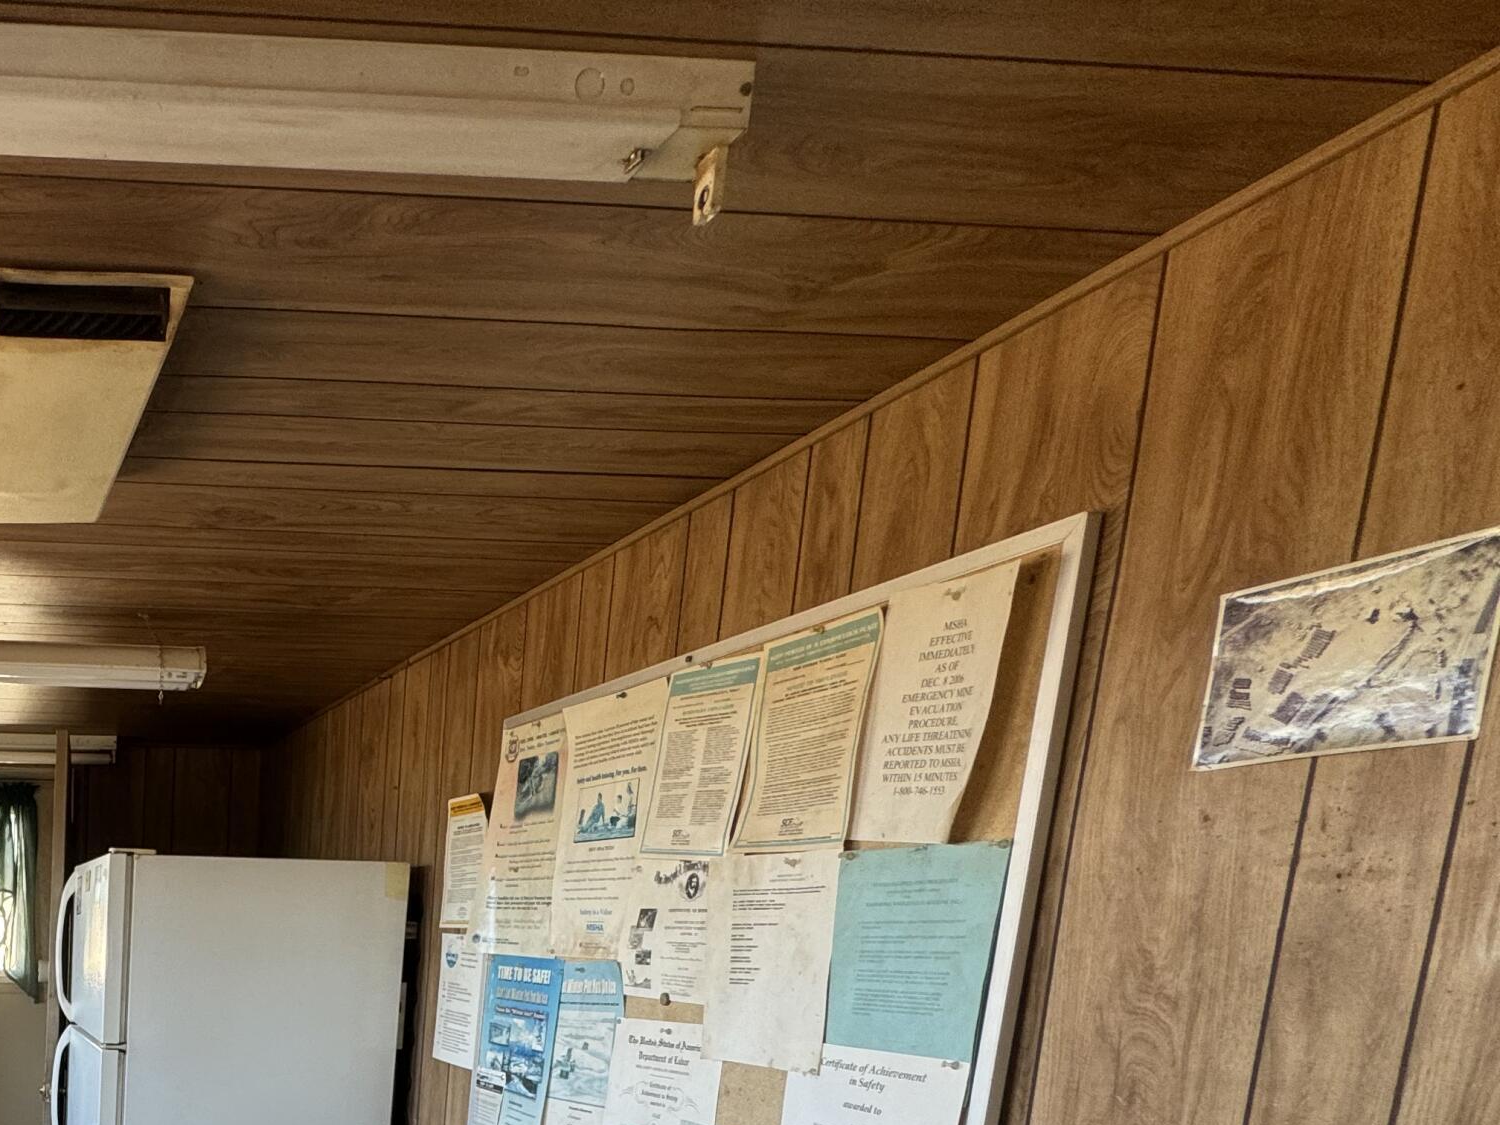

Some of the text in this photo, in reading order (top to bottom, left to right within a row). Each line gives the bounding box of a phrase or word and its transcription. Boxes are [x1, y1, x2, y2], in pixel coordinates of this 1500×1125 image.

[943, 618, 968, 631] MSHA
[929, 630, 974, 648] EFFECTIVE
[918, 643, 976, 662] IMMEDIATELY
[935, 660, 961, 673] AS OF
[901, 686, 975, 703] EMERGENCY MINE
[909, 702, 964, 716] EVACUATION
[881, 728, 974, 745] ANY LIFE THREATENING
[885, 743, 966, 758] ACCIDENTS MUST BE
[882, 758, 927, 770] REPORTED
[928, 758, 940, 769] TO
[882, 773, 912, 783] WITHIN
[913, 772, 923, 783] 15
[498, 965, 551, 985] TIME TO BE SAFE!
[858, 1063, 869, 1076] of
[868, 1066, 928, 1083] Achievement
[848, 1077, 886, 1094] in Safety
[842, 1101, 883, 1116] awarded to
